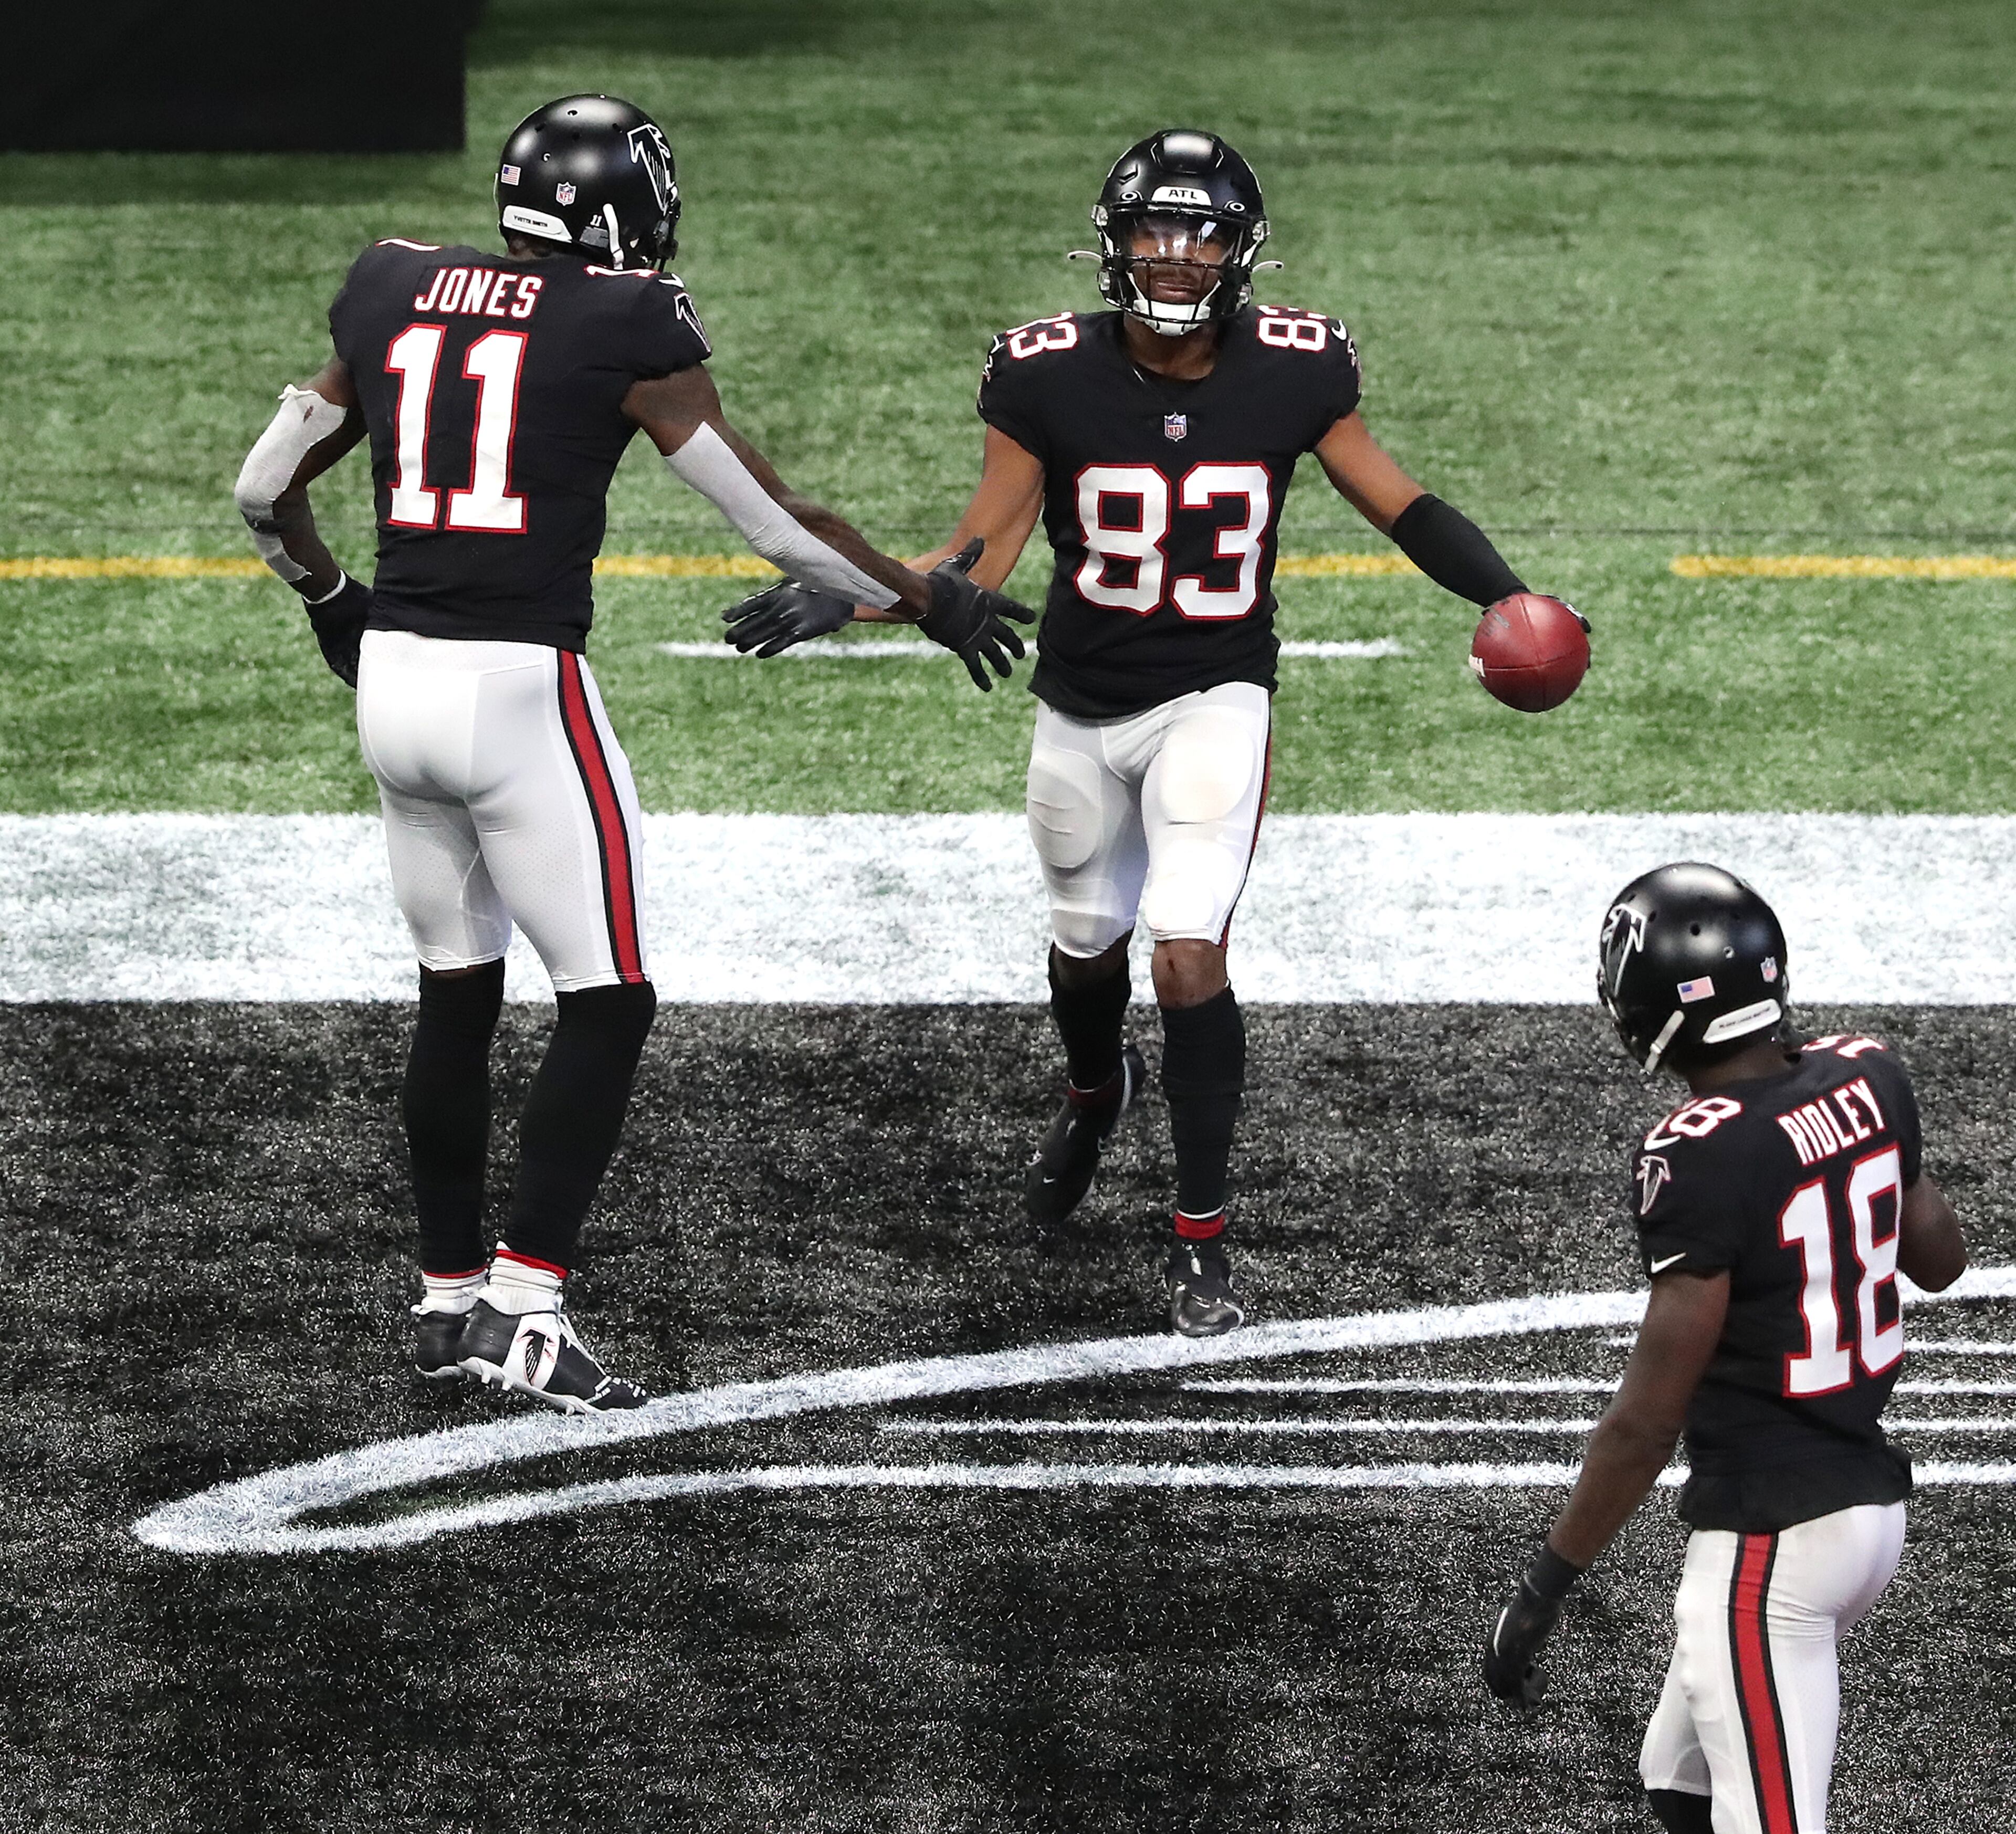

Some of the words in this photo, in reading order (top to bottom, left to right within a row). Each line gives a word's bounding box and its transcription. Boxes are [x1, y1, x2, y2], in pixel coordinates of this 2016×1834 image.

[558, 192, 573, 202] NFL
[590, 214, 602, 227] 11
[1169, 190, 1197, 200] ATL
[414, 267, 544, 321] JONES
[1256, 304, 1329, 353] 8
[385, 323, 529, 534] 11
[1167, 426, 1185, 437] NFL
[1072, 460, 1272, 620] 83
[1776, 1076, 1886, 1167] RIDLEY
[1777, 1142, 1905, 1398] 18
